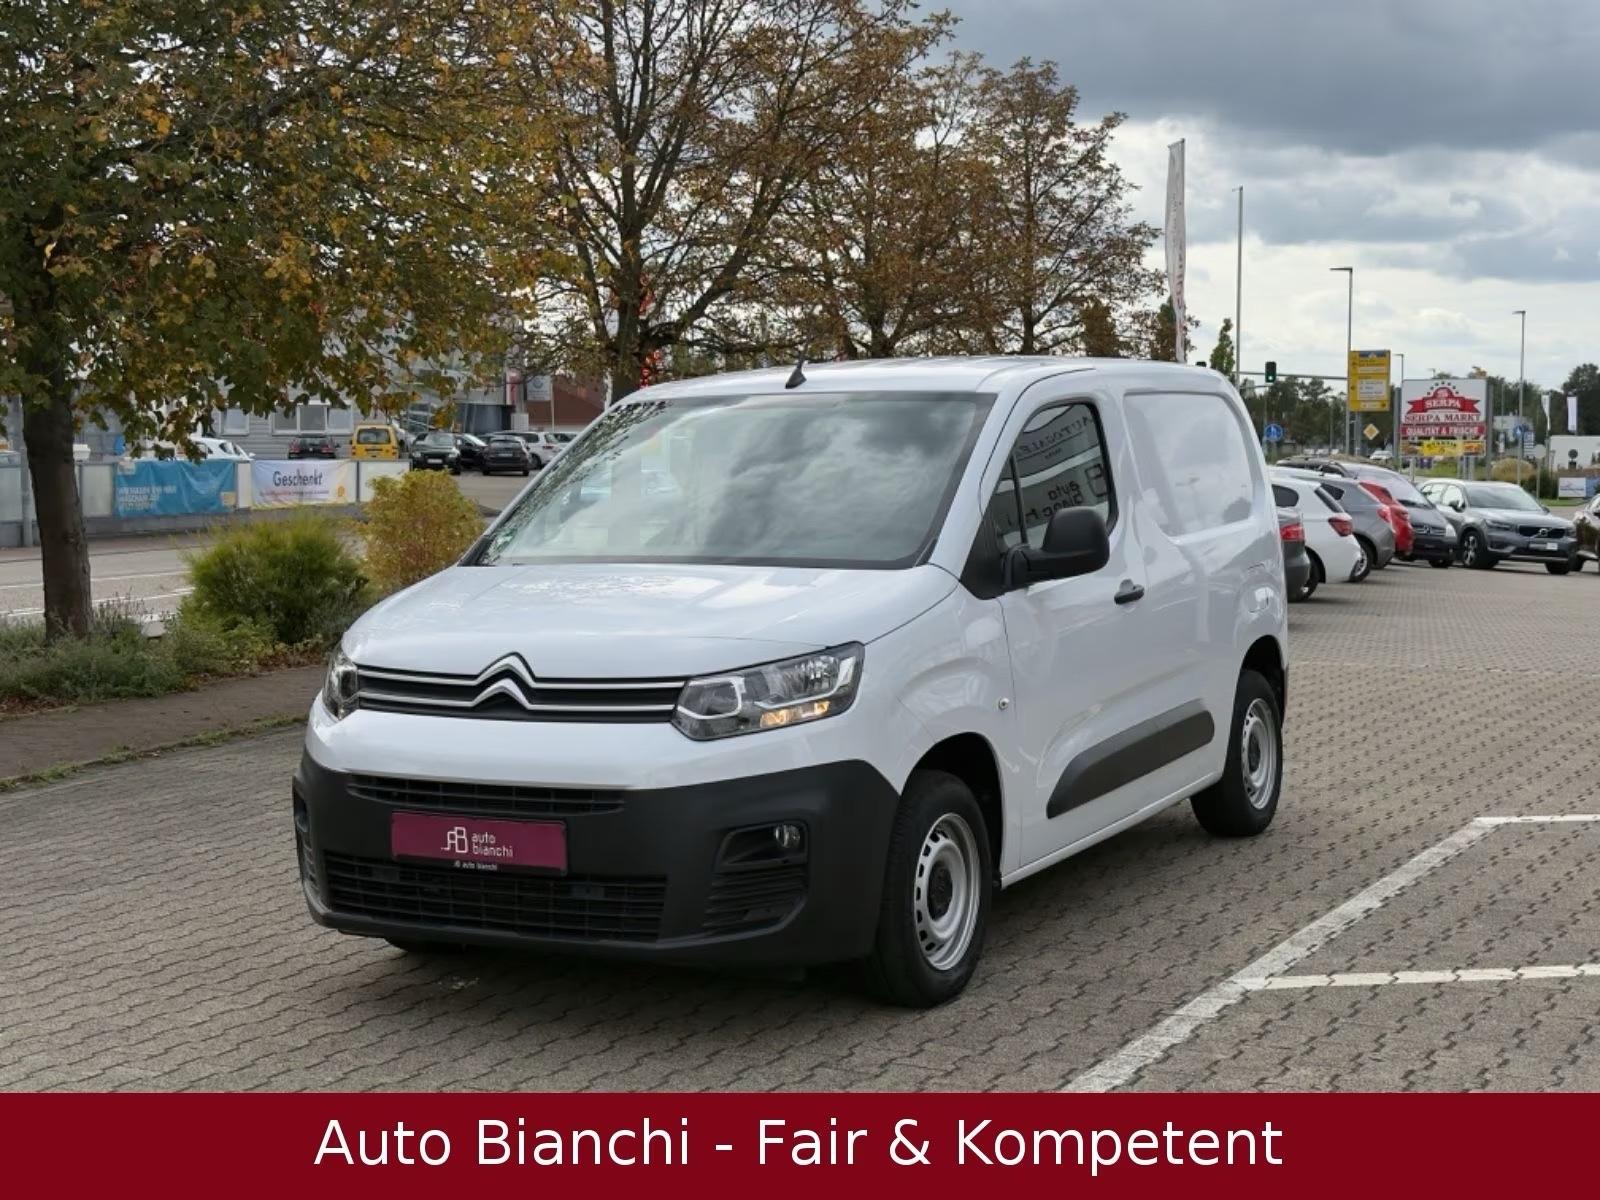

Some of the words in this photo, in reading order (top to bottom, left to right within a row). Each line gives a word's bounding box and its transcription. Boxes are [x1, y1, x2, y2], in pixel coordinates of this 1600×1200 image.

[1424, 399, 1461, 409] SERPA
[1405, 413, 1441, 422] SERPA
[1444, 413, 1480, 422] MARKT
[272, 468, 323, 487] Geschenkt
[471, 832, 496, 844] auto
[472, 844, 514, 858] bianchi
[462, 861, 475, 870] auto
[477, 861, 498, 871] bianchi
